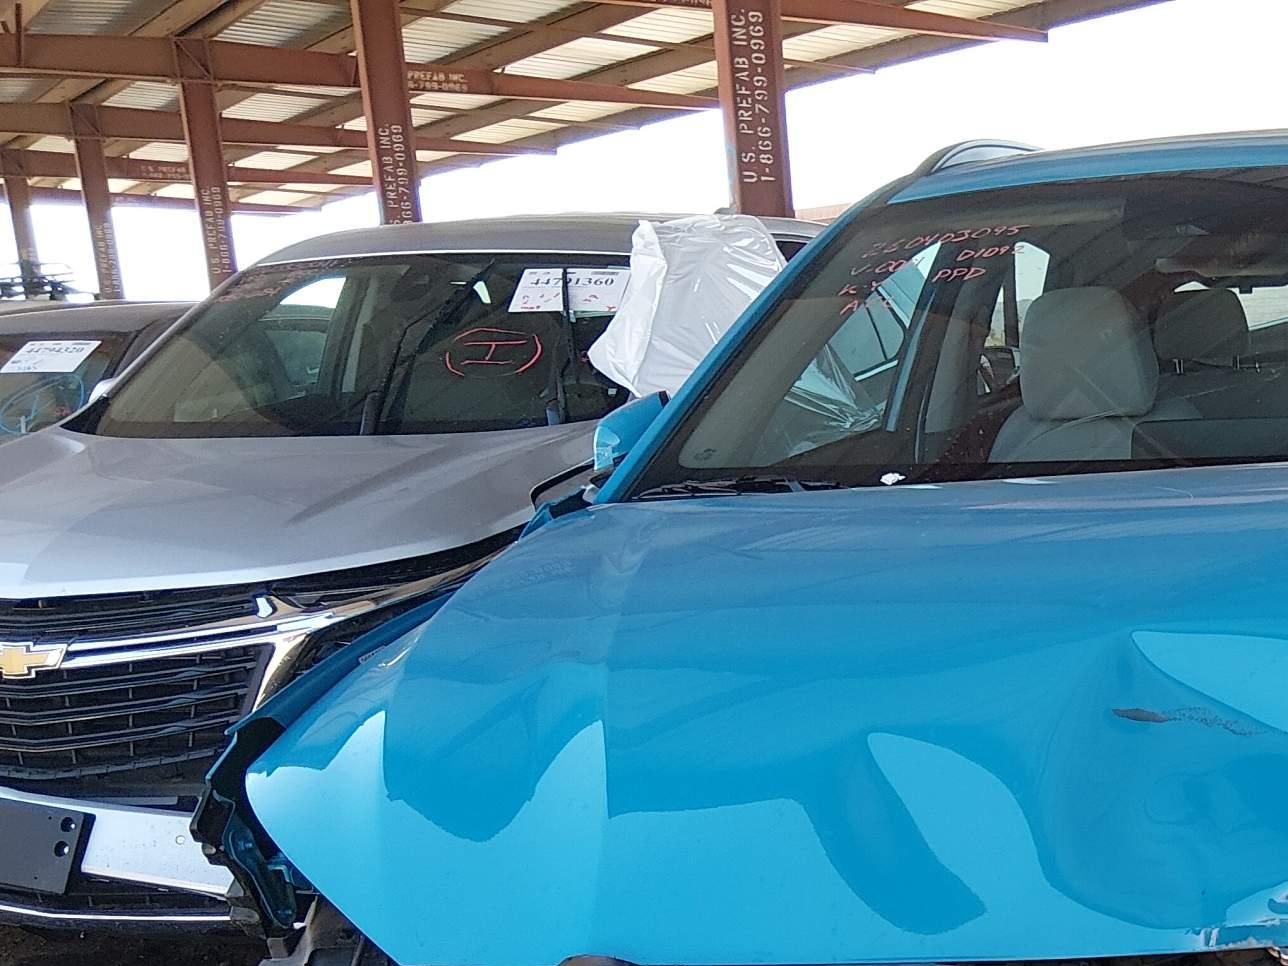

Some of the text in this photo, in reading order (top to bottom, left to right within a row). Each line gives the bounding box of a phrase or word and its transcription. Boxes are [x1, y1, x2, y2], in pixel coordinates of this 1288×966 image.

[731, 9, 747, 46] INC.
[408, 70, 445, 82] PREFAB
[734, 57, 754, 133] PREFAB
[748, 11, 776, 182] 1-866-799-0969
[382, 157, 399, 207] PREFAB
[931, 267, 987, 283] PPD
